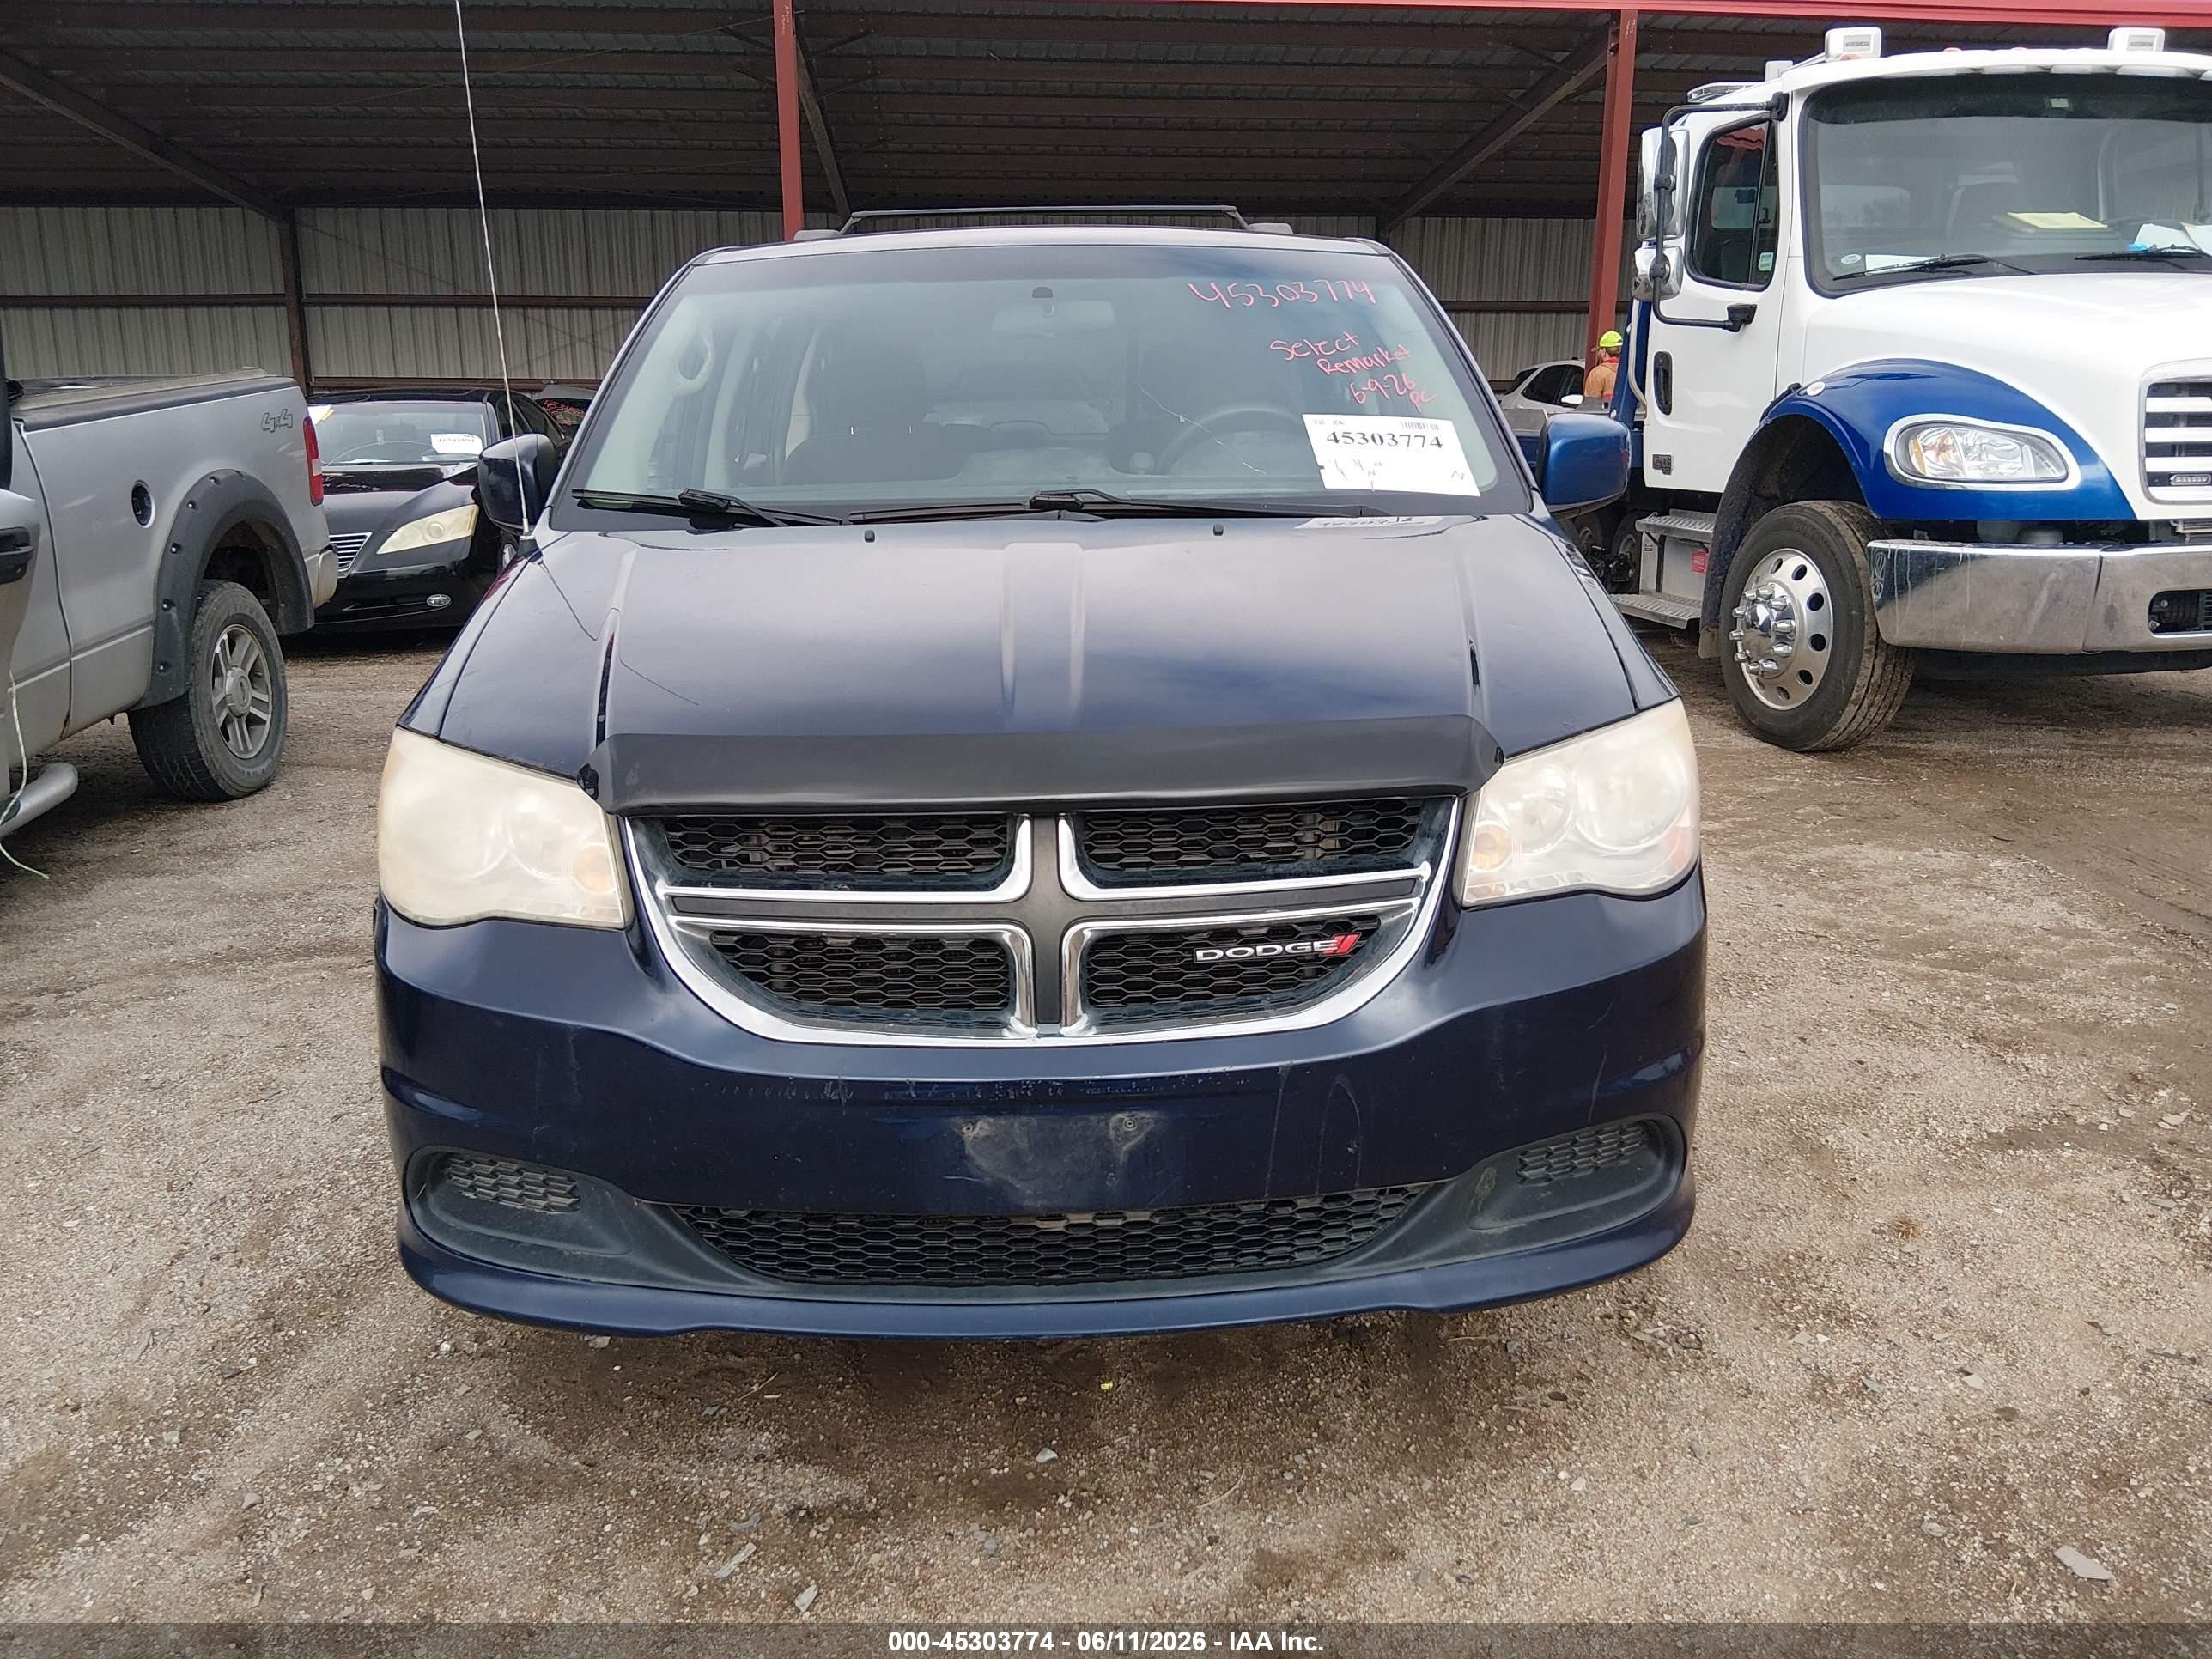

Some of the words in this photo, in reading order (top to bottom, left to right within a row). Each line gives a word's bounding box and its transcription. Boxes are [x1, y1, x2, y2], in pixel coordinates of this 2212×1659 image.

[1188, 279, 1376, 309] 45303774
[1350, 373, 1416, 404] 6-9-26
[1327, 431, 1443, 449] 45303774
[1195, 939, 1338, 962] DODGE
